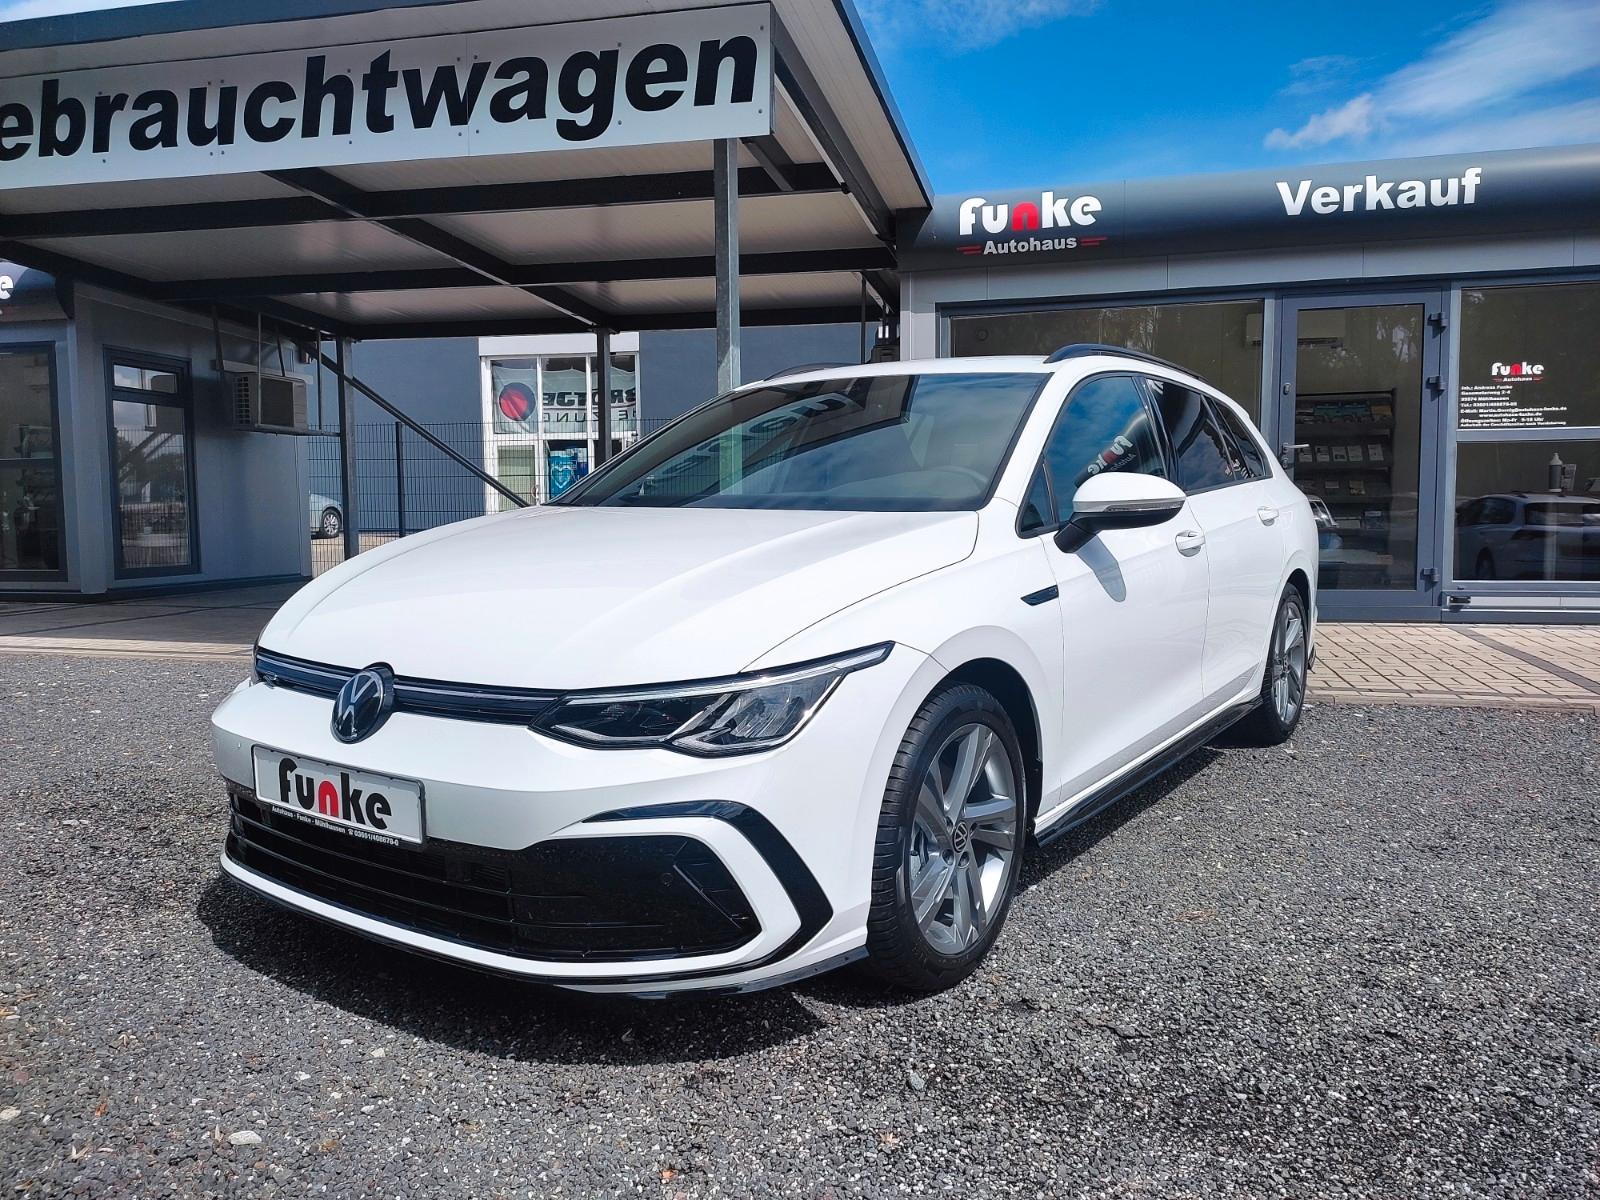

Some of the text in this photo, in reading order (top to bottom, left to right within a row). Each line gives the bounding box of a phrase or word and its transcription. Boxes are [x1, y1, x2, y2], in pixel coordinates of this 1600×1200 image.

[1276, 167, 1482, 216] Verkauf
[959, 191, 1102, 236] funke
[983, 237, 1078, 255] Autohaus
[1491, 362, 1545, 376] funke
[278, 757, 392, 830] funke
[271, 805, 294, 818] Autohaus
[296, 813, 311, 823] Funke
